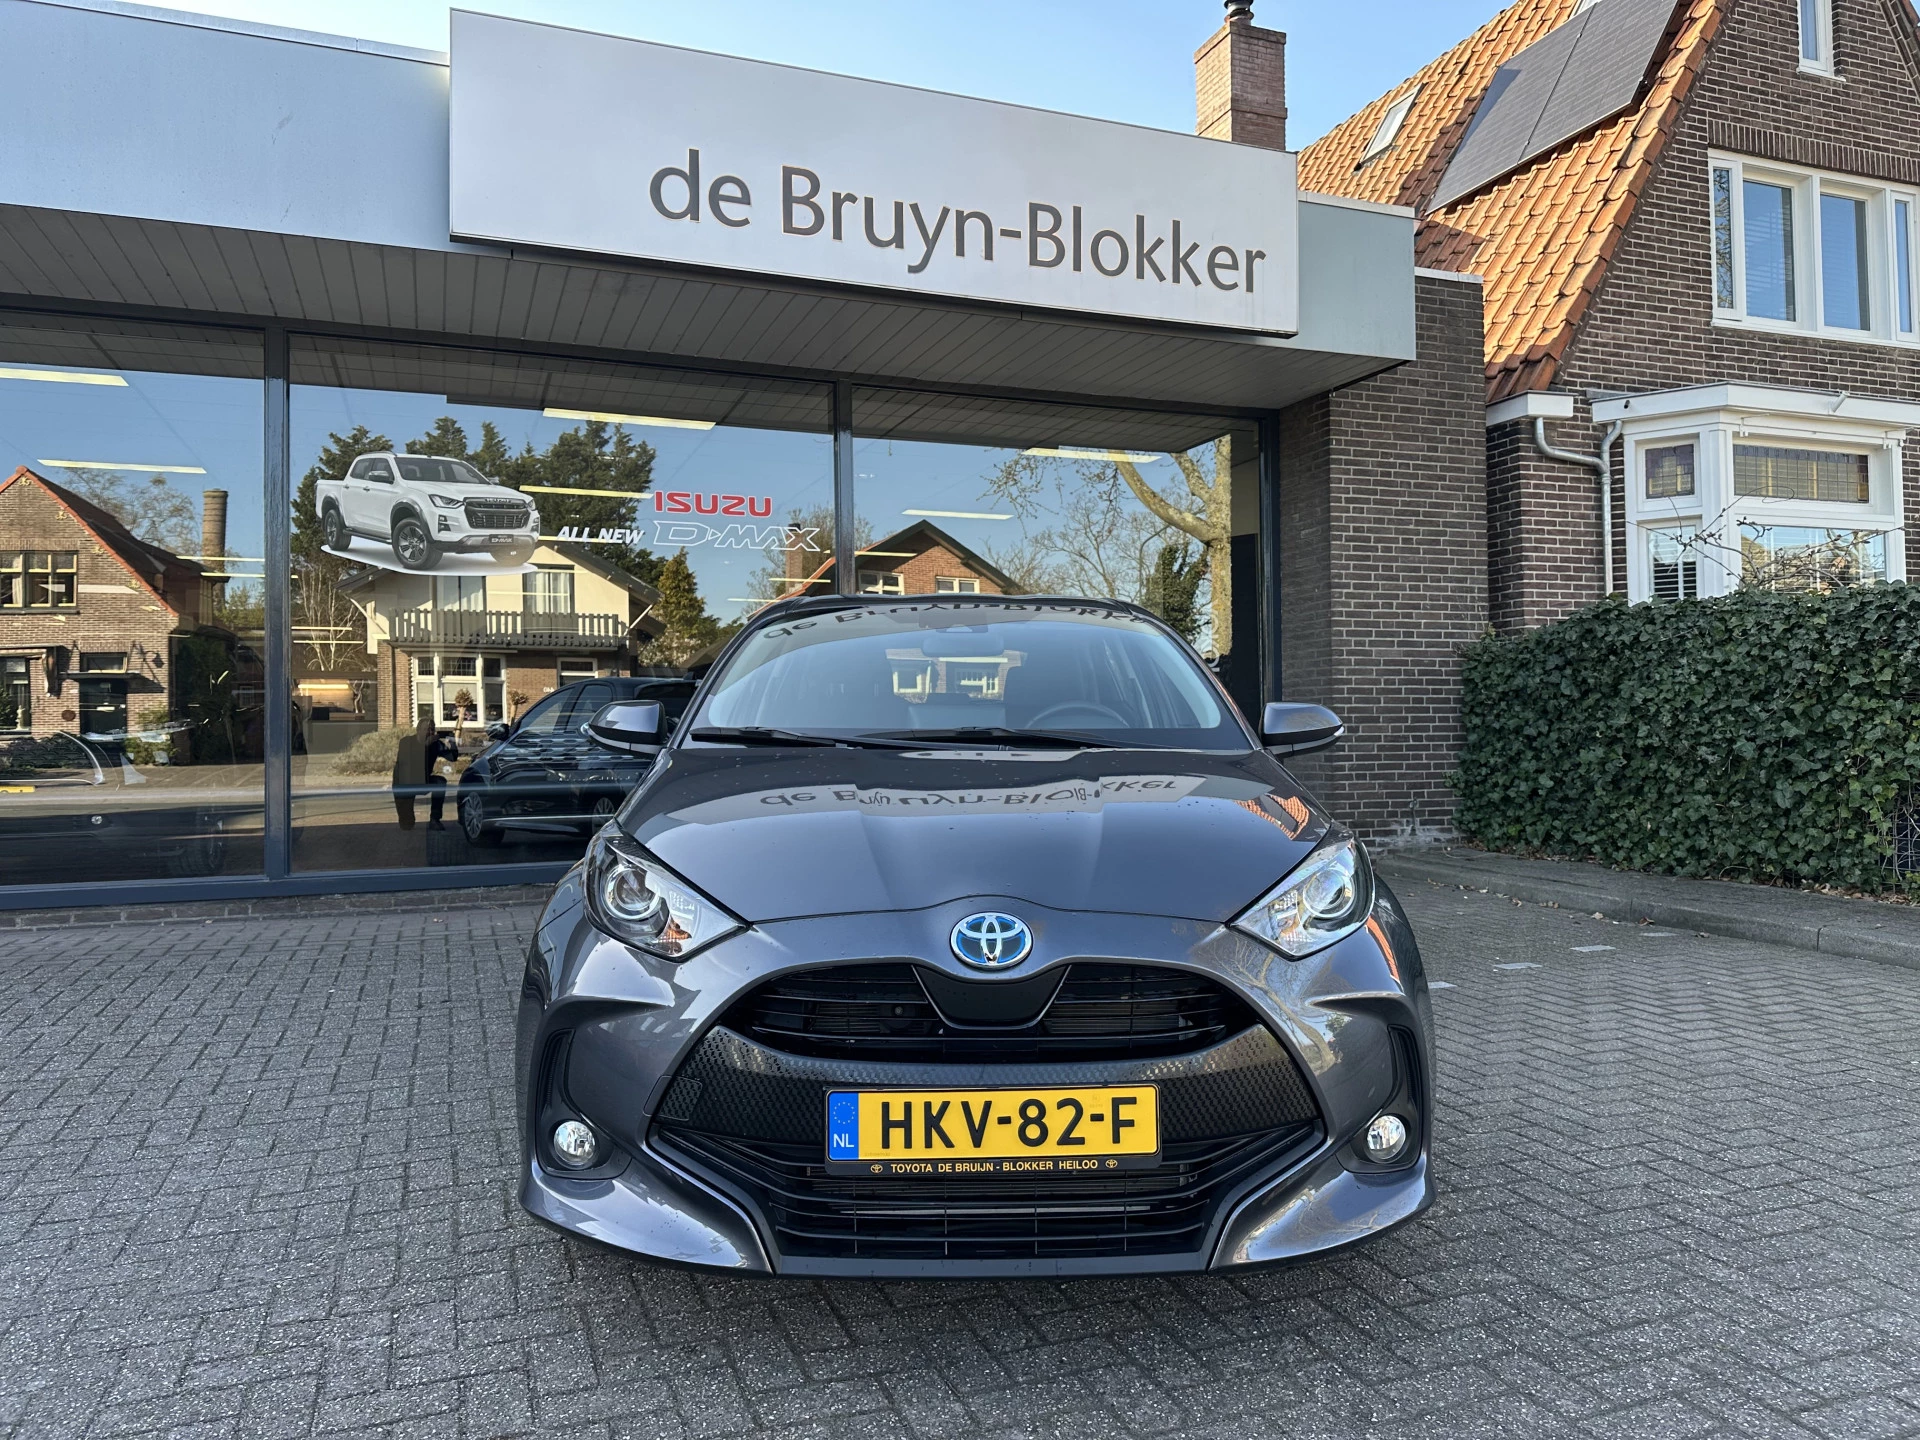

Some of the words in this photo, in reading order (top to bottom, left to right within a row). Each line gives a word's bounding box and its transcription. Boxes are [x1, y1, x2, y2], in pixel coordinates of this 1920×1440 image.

[649, 148, 751, 228] de
[780, 164, 1267, 293] Bruyn-Blokker
[654, 491, 772, 517] ISUZU
[557, 526, 597, 541] ALL
[598, 528, 645, 545] NEW
[880, 1096, 1138, 1149] HKV-82-F
[833, 1133, 855, 1148] NL
[890, 1163, 933, 1173] TOYOTA
[938, 1163, 953, 1173] DE
[955, 1161, 994, 1172] BRUIJN
[1002, 1161, 1054, 1171] BLOKKER
[1058, 1159, 1099, 1170] HEILOO
